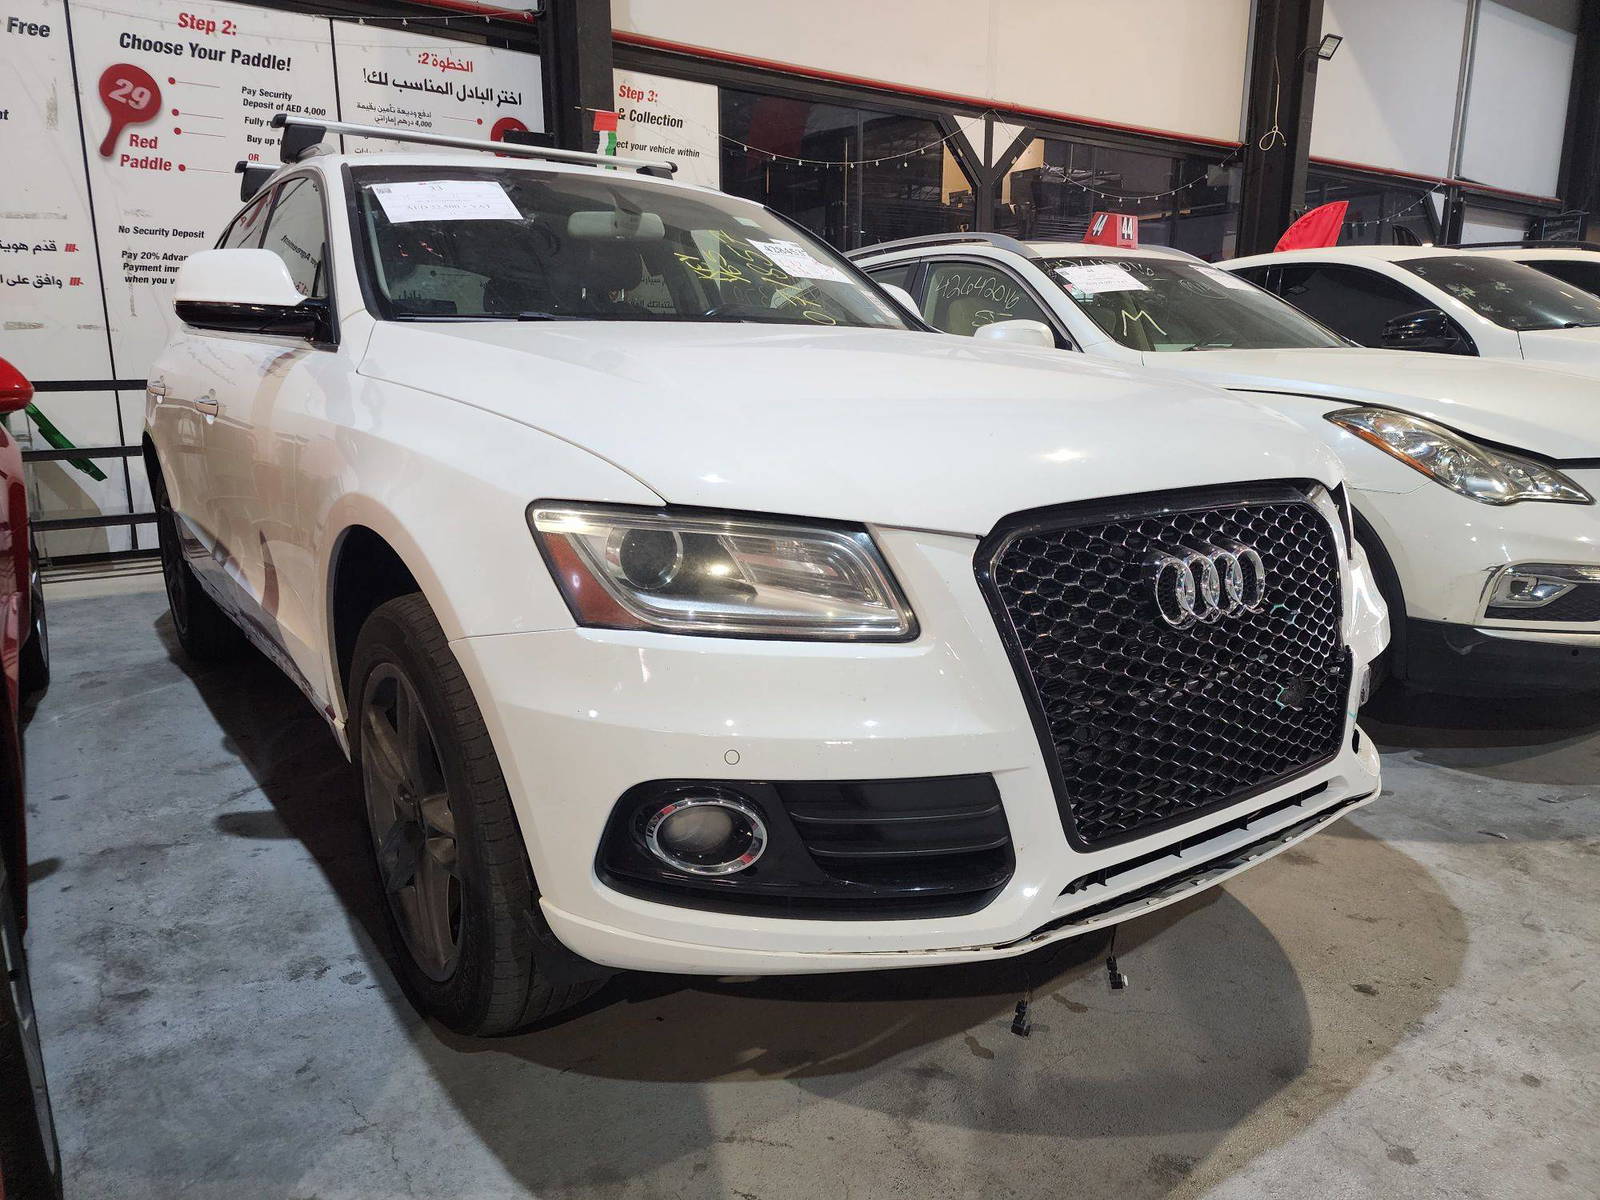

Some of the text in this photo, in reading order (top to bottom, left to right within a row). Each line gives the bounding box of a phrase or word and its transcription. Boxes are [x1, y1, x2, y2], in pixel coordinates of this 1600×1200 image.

[7, 16, 50, 37] Free
[178, 12, 237, 36] Step 2:
[119, 32, 292, 72] Choose Your Paddle!
[432, 53, 473, 73] الخطوة
[108, 78, 151, 110] 29
[241, 86, 292, 101] Pay Security
[392, 78, 453, 95] المناسب
[456, 84, 493, 105] البادل
[618, 84, 658, 103] Step 3:
[242, 98, 326, 116] Deposit of AED 4,000
[496, 91, 522, 107] اختر
[244, 116, 265, 127] Fully
[618, 107, 683, 128] & Collection
[129, 133, 158, 149] Red
[246, 134, 262, 144] Buy
[264, 138, 274, 146] up
[248, 153, 259, 161] OR
[630, 142, 647, 151] your
[649, 144, 675, 154] vehicle
[677, 148, 700, 157] within
[120, 154, 172, 171] Paddle
[118, 225, 204, 239] No Security Deposit
[1092, 214, 1108, 237] 44
[1121, 216, 1134, 240] 44
[121, 250, 138, 260] Pay
[140, 252, 160, 260] 20%
[123, 263, 162, 272] Payment
[6, 275, 30, 287] على
[32, 273, 63, 289] وافق
[124, 275, 149, 283] when
[151, 277, 167, 285] you
